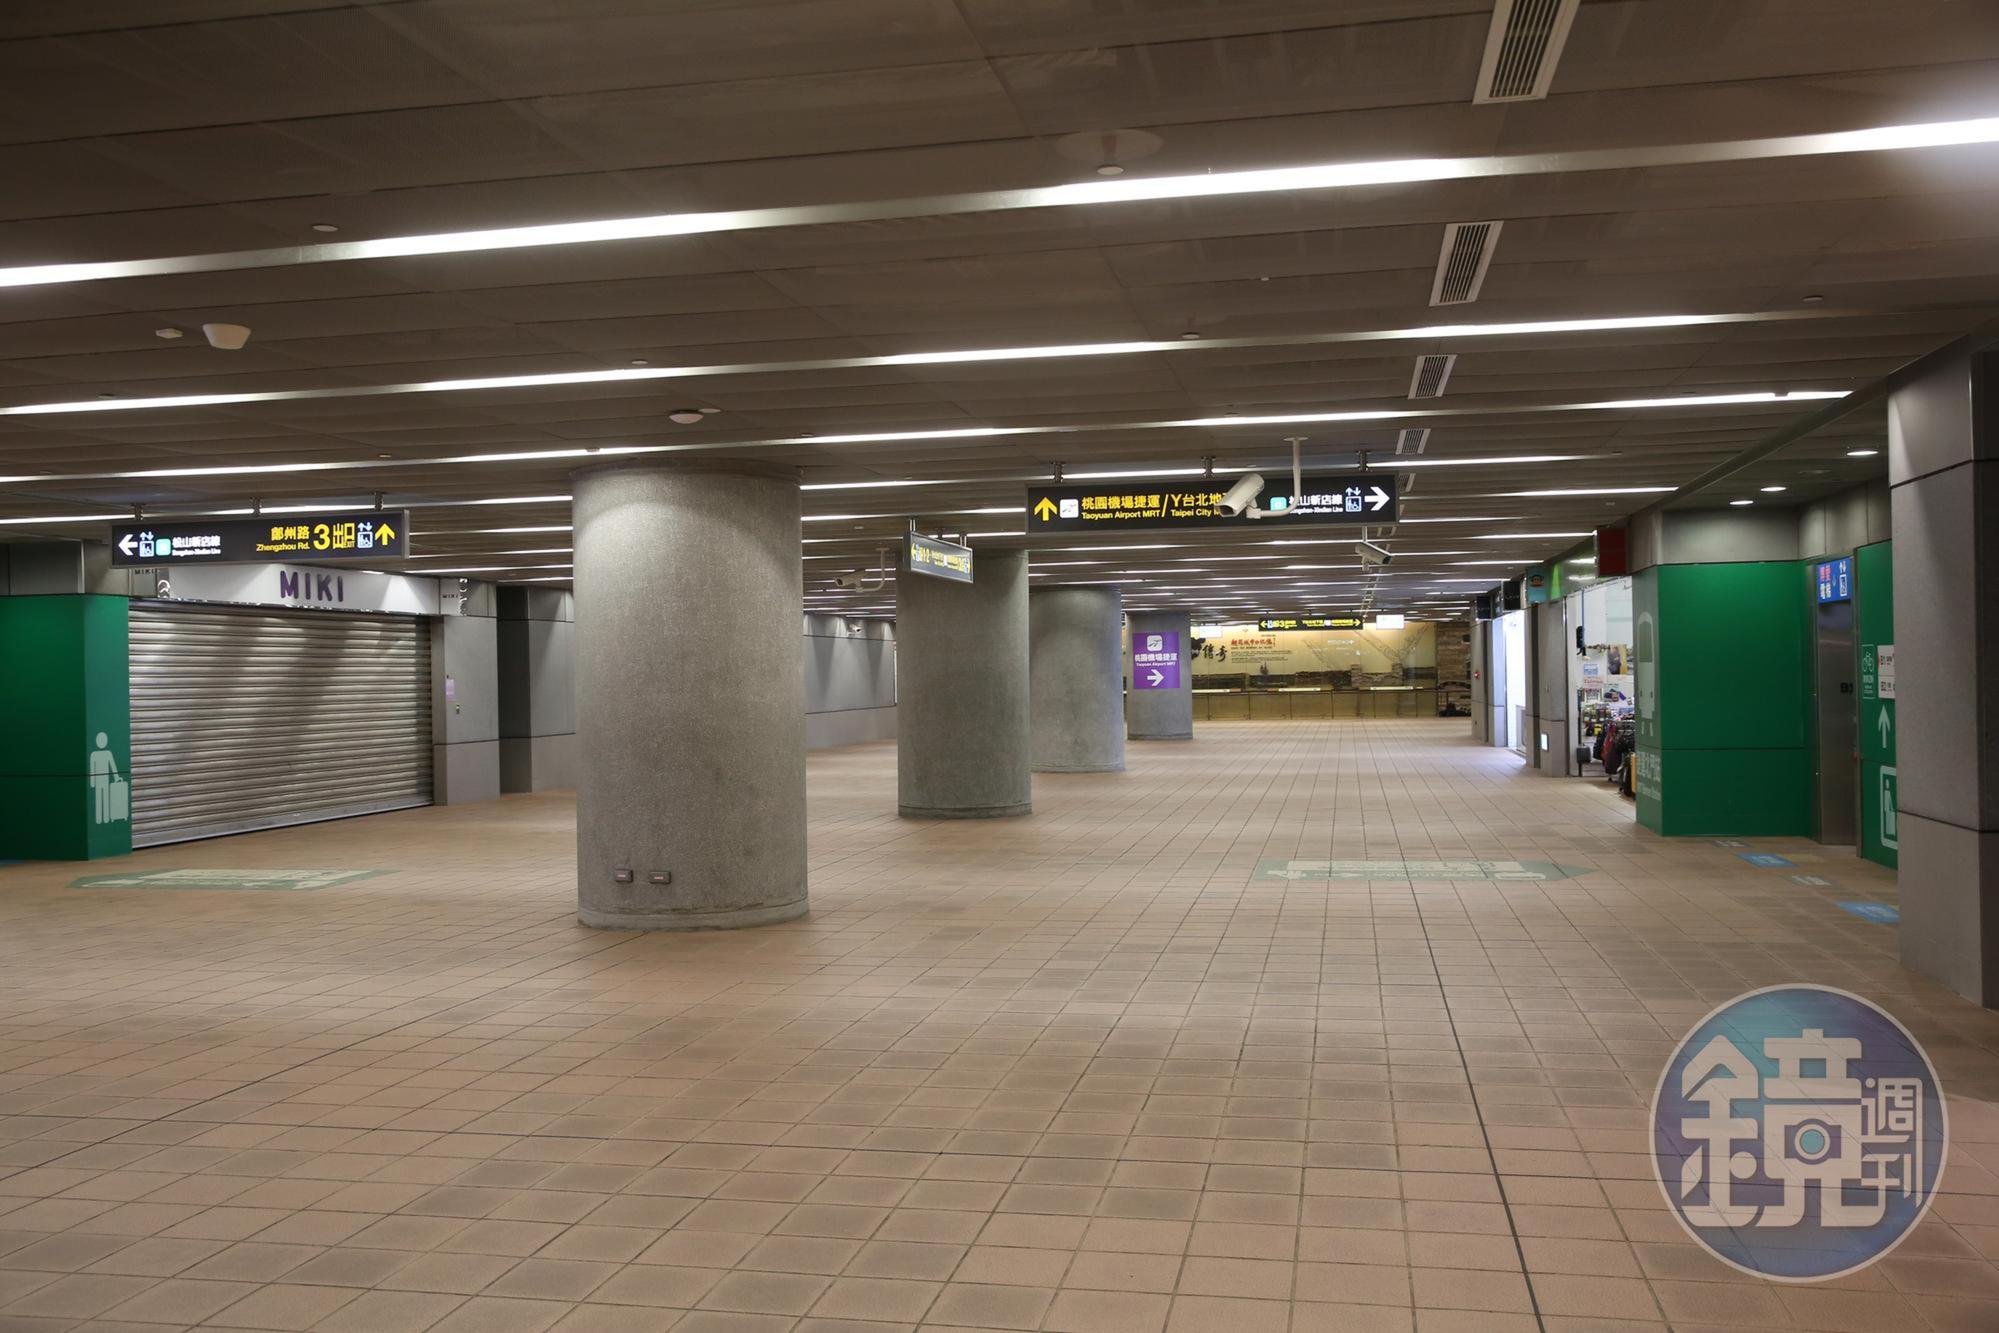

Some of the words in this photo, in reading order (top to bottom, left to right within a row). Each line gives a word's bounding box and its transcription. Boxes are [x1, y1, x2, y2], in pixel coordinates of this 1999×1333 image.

[1081, 494, 1160, 510] 桃園機場捷運
[1081, 511, 1113, 520] Taoyuan
[1114, 510, 1142, 519] Airport
[1142, 510, 1160, 518] MRT
[1171, 509, 1194, 518] Taipei
[1196, 508, 1212, 517] City
[271, 526, 310, 541] 鄭州路
[313, 523, 331, 550] 3
[332, 523, 355, 549] 出口
[256, 542, 297, 553] Zhengzhou
[297, 541, 311, 550] Rd.
[280, 570, 344, 602] MIKI
